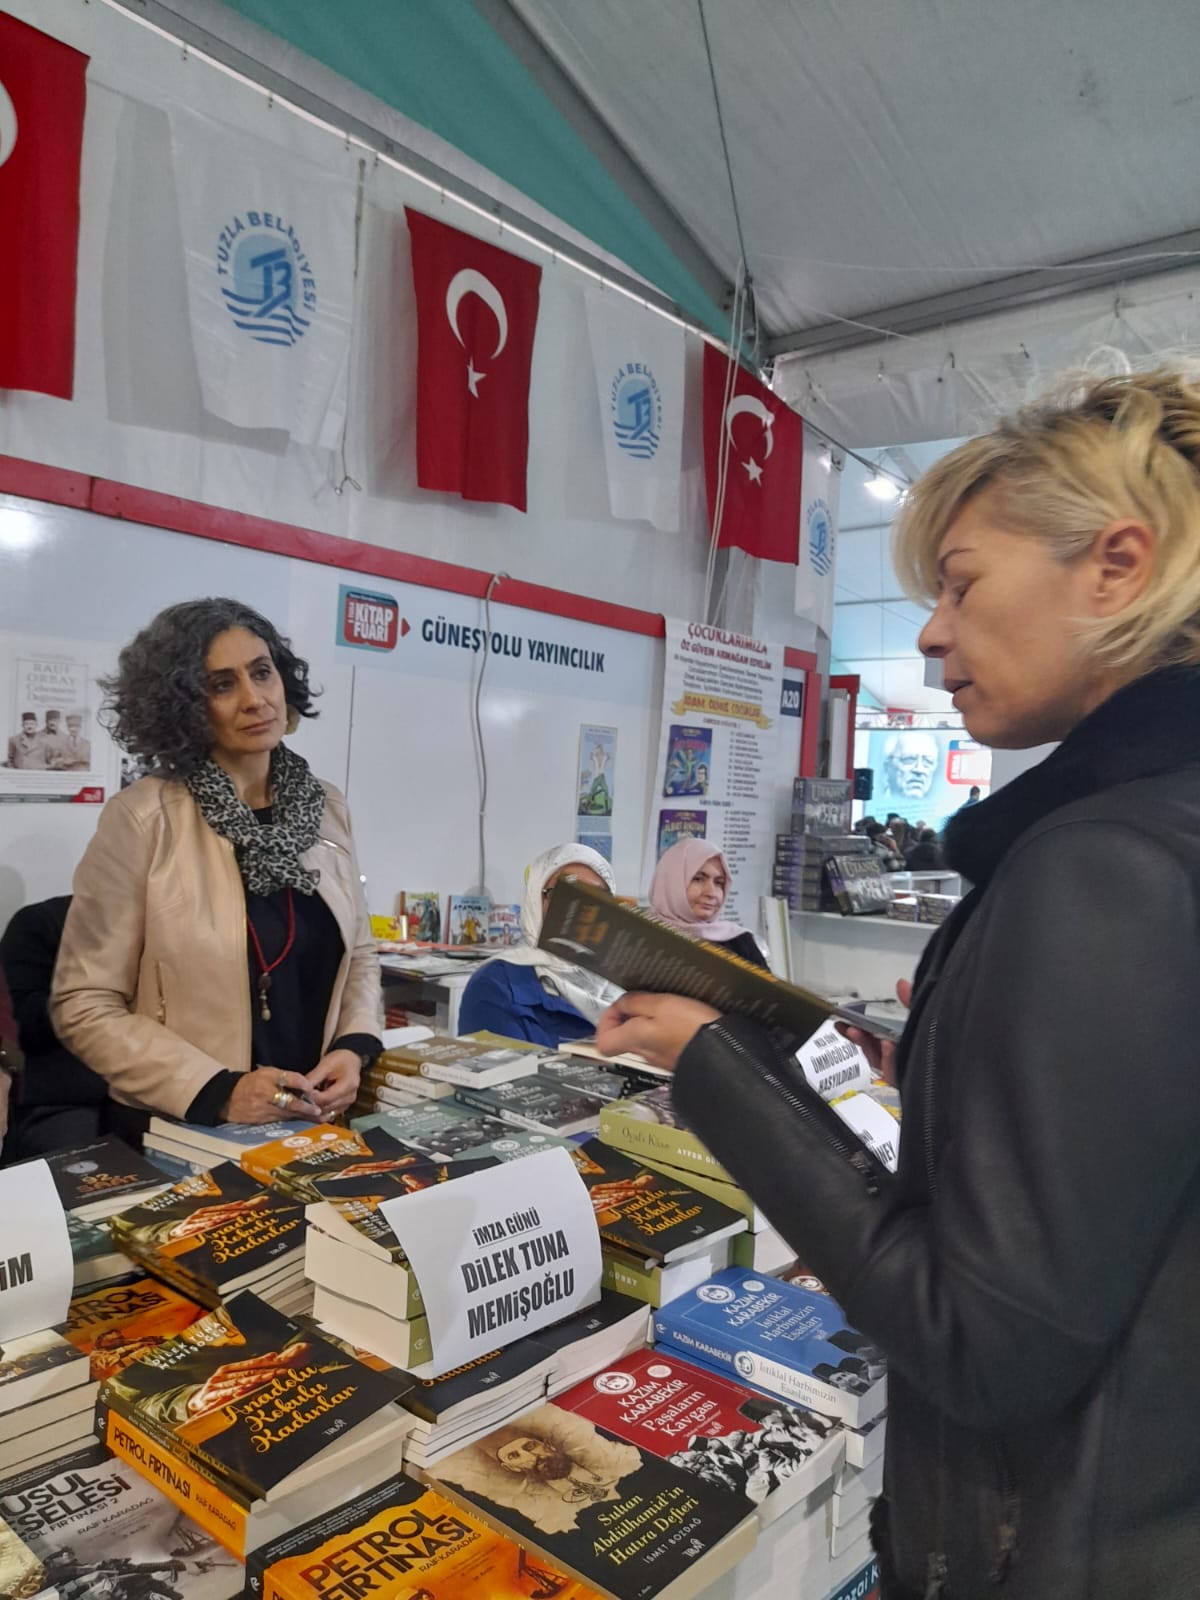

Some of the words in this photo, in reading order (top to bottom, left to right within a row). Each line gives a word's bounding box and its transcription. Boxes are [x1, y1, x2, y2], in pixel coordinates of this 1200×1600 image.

[217, 216, 245, 275] TUZLA
[353, 620, 389, 642] FUARI
[354, 602, 393, 625] KİTAP
[527, 639, 605, 673] YAYINCILIK
[781, 690, 800, 709] A20
[472, 1221, 507, 1246] İMZA
[505, 1206, 541, 1236] GÜNÜ
[461, 1247, 520, 1293] DİLEK
[519, 1230, 569, 1271] TUNA
[467, 1268, 575, 1339] MEMİŞOĞLU
[722, 1293, 760, 1316] KAZIM
[727, 1292, 783, 1327] KARABEKİR
[673, 1331, 695, 1349] KAZIM
[695, 1340, 733, 1363] KARABEKİR
[224, 1366, 319, 1426] Anadolu
[244, 1382, 328, 1433] Kokulu
[617, 1380, 662, 1408] KAZIM
[619, 1378, 688, 1424] KARABEKİR
[787, 1374, 838, 1404] Harbimizin
[641, 1391, 706, 1432] Paşaların
[660, 1400, 719, 1437] Kavgası
[114, 1427, 148, 1468] PETROL
[148, 1455, 192, 1500] FIRTINASI
[50, 1502, 110, 1532] FIRTINASI
[592, 1485, 685, 1557] Abdülhamid'in
[597, 1494, 644, 1527] Sultan
[608, 1531, 658, 1566] Hatıra
[653, 1495, 700, 1533] Defteri
[299, 1508, 454, 1592] PETROL
[319, 1516, 475, 1600] FIRTINASI
